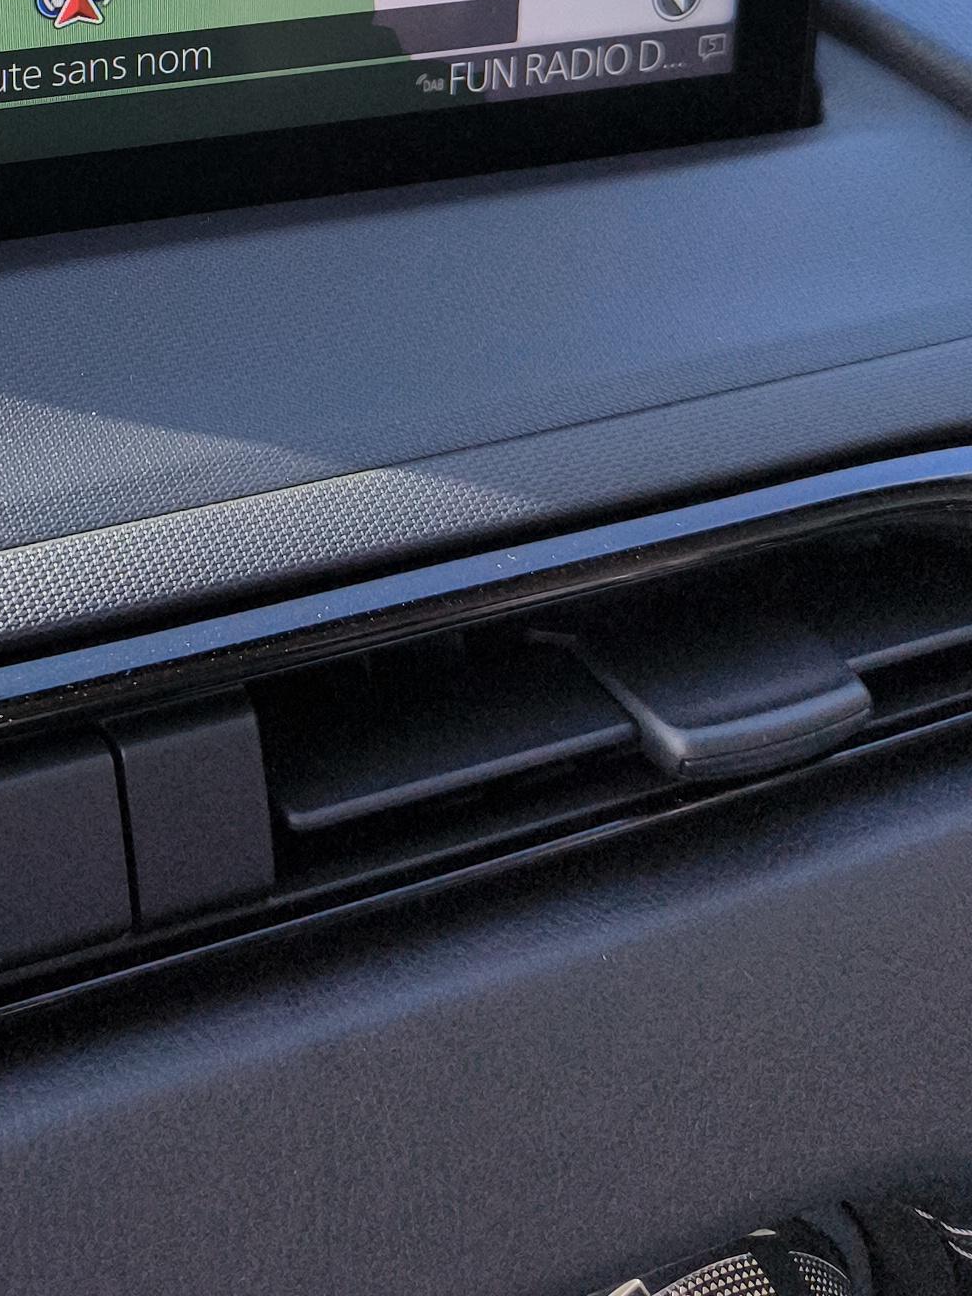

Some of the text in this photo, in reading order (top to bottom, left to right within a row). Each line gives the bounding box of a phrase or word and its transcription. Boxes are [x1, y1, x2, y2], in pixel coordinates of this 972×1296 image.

[51, 54, 127, 87] sans
[135, 44, 213, 75] nom
[423, 78, 444, 93] DAB
[450, 55, 517, 95] FUN
[525, 43, 630, 85] RADIO
